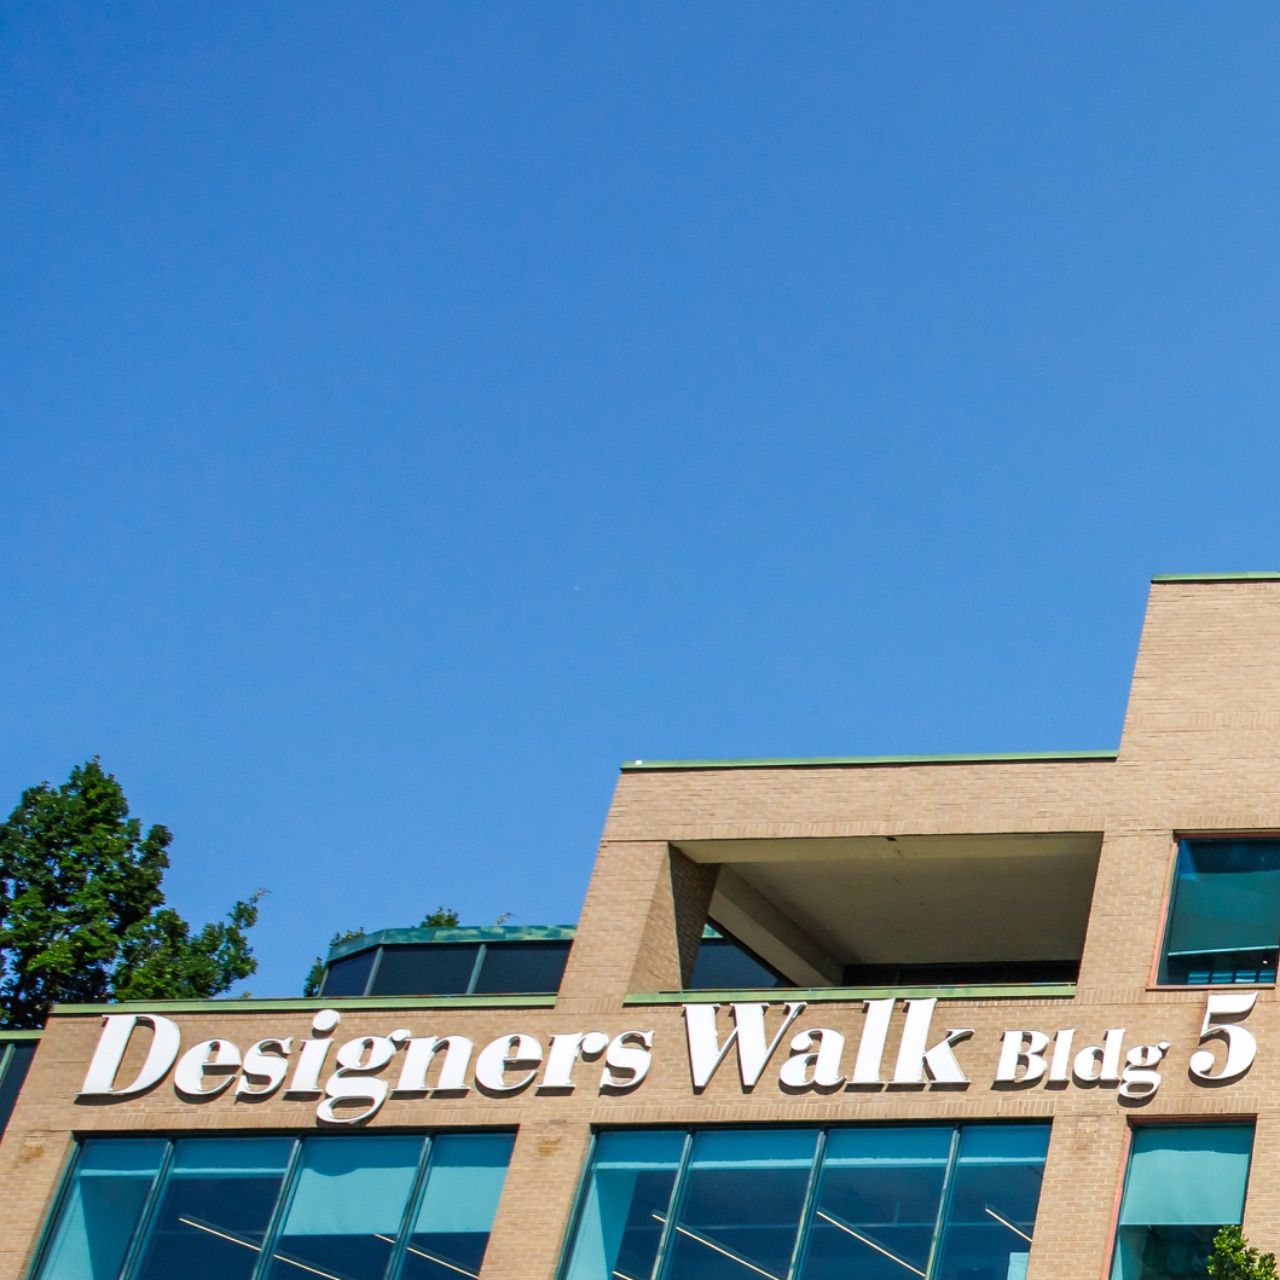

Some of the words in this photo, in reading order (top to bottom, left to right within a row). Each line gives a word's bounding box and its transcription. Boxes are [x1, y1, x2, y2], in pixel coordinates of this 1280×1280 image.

[75, 1009, 655, 1124] Designers
[683, 997, 975, 1088] Walk
[996, 1027, 1171, 1099] Bldg
[1189, 991, 1259, 1080] 5
